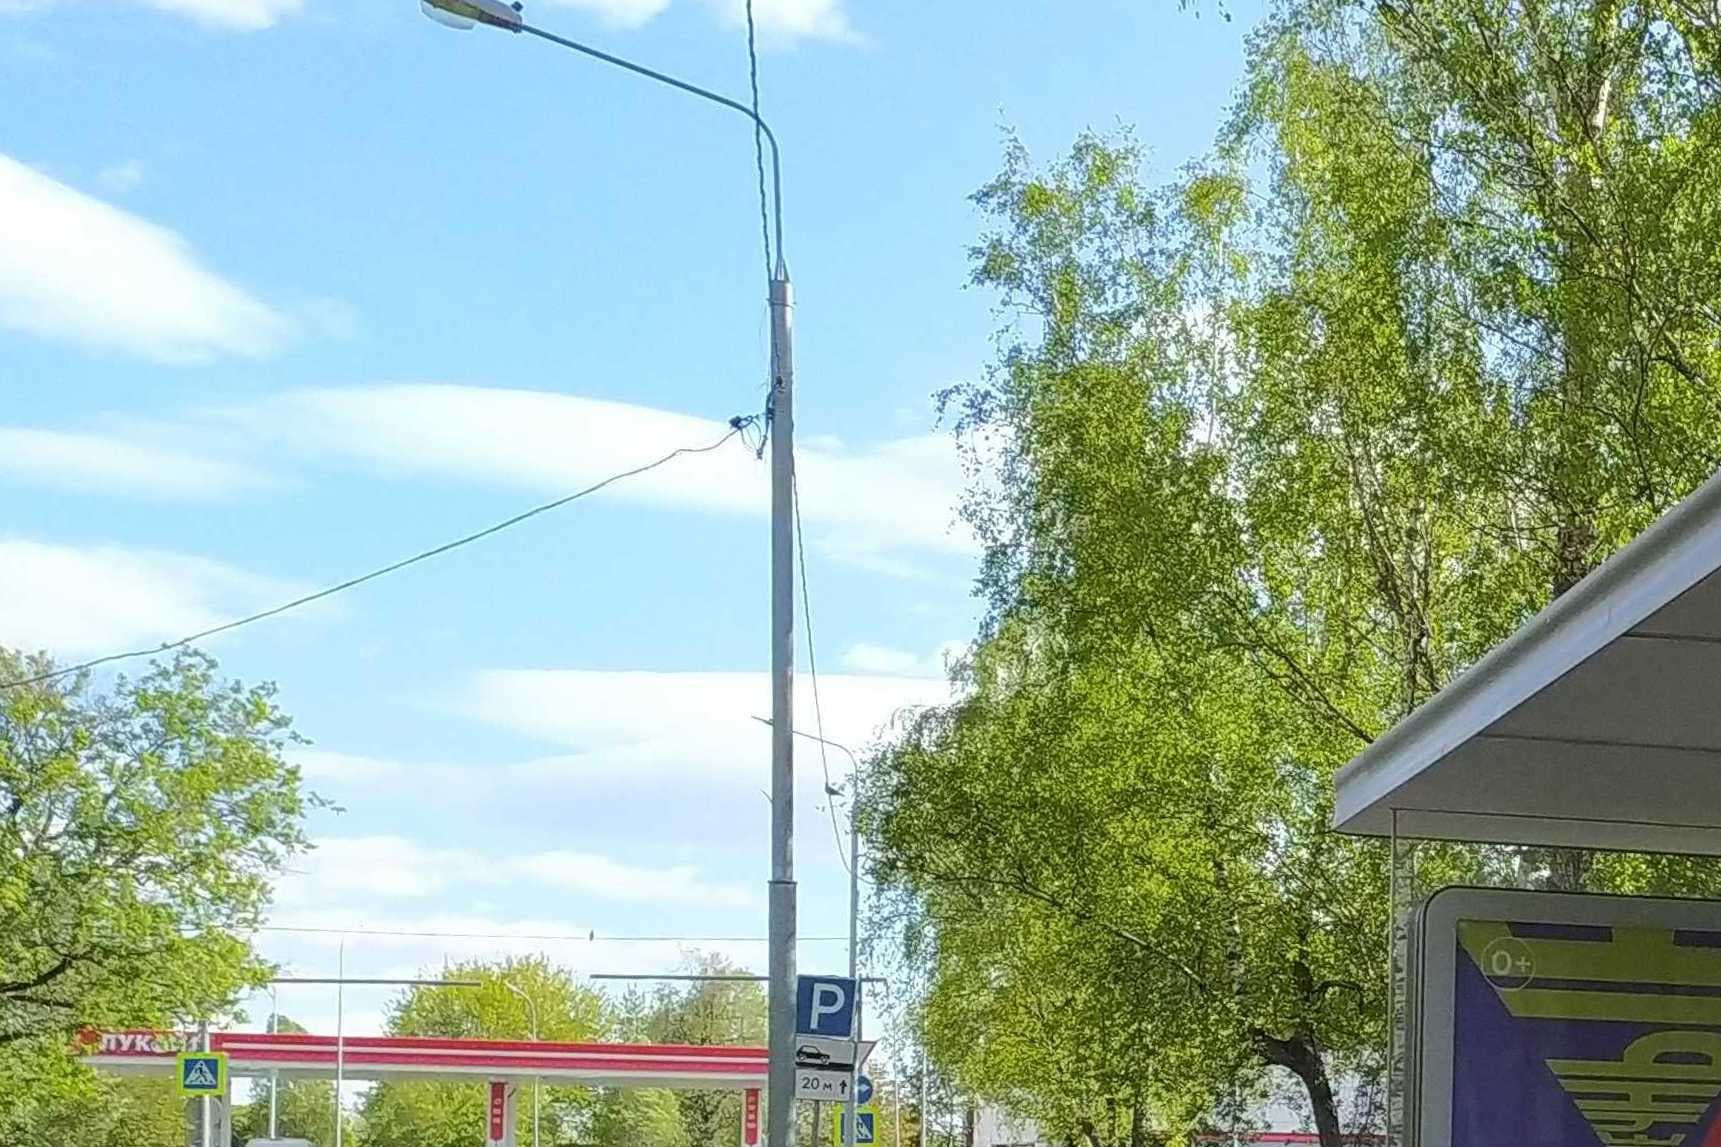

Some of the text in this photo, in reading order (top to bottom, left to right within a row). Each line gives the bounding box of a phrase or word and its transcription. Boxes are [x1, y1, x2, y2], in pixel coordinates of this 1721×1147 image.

[1491, 950, 1531, 976] 0+
[810, 983, 845, 1029] P
[802, 1076, 820, 1090] 20
